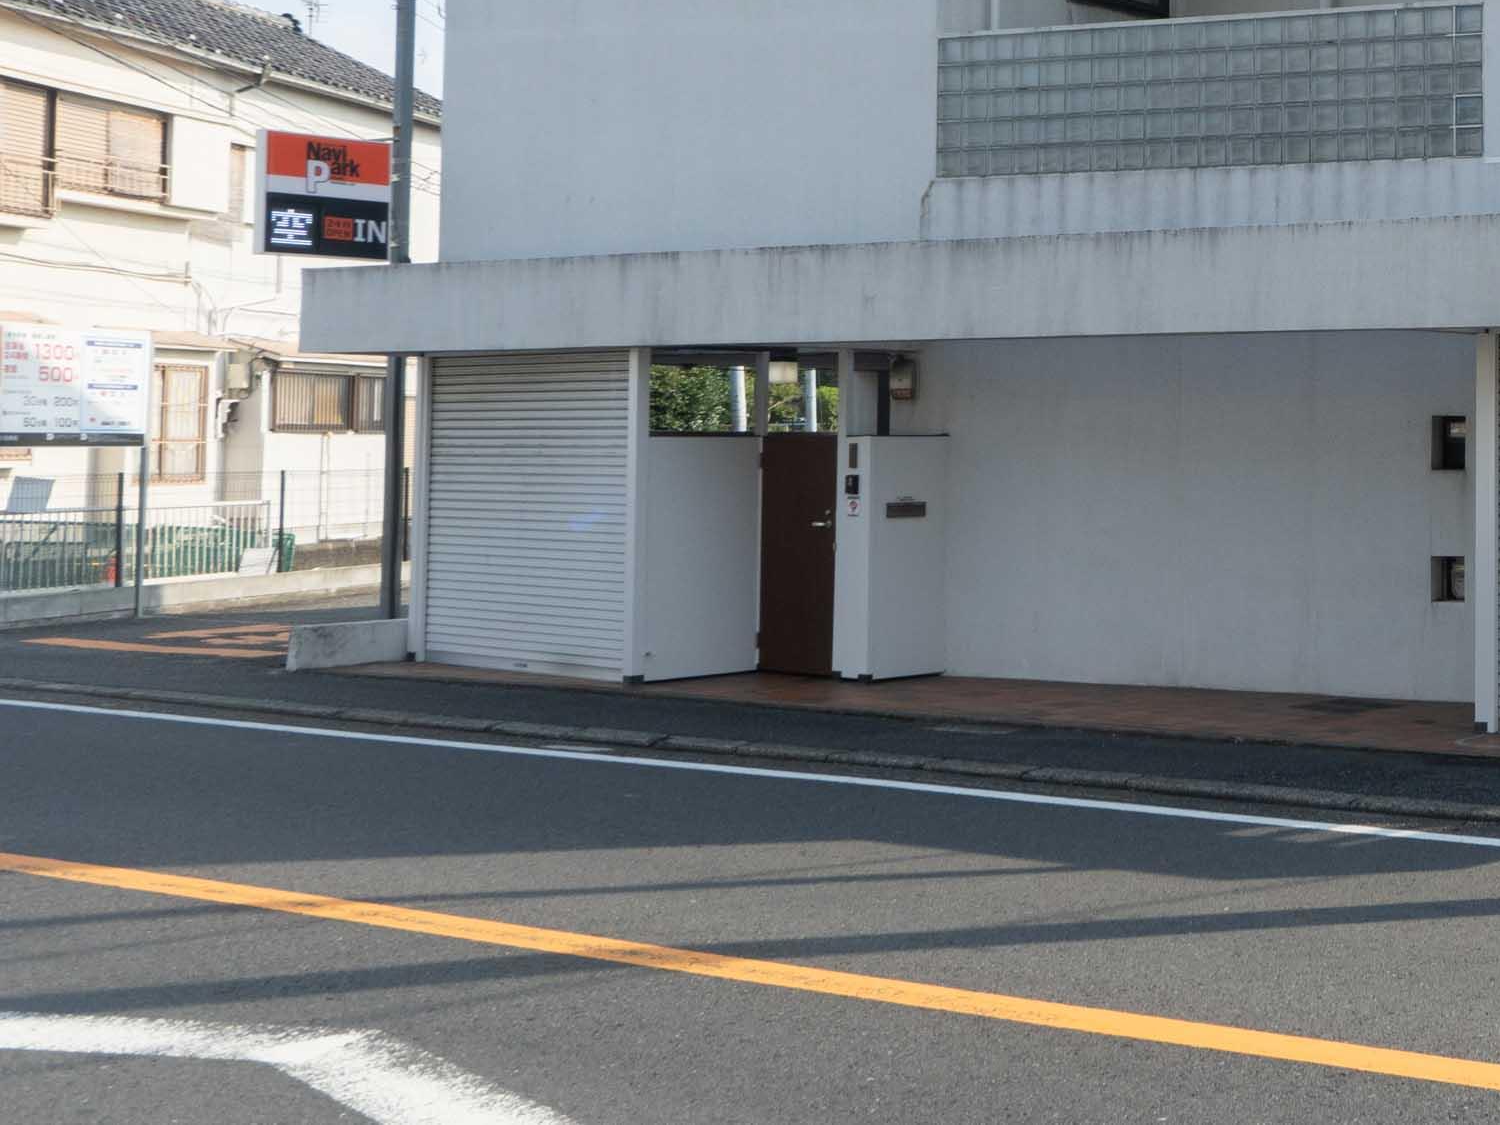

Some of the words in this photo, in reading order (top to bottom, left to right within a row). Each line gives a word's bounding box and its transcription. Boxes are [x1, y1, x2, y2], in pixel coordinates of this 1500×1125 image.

[307, 141, 346, 163] Navi
[306, 159, 360, 194] Park
[354, 218, 387, 244] IN
